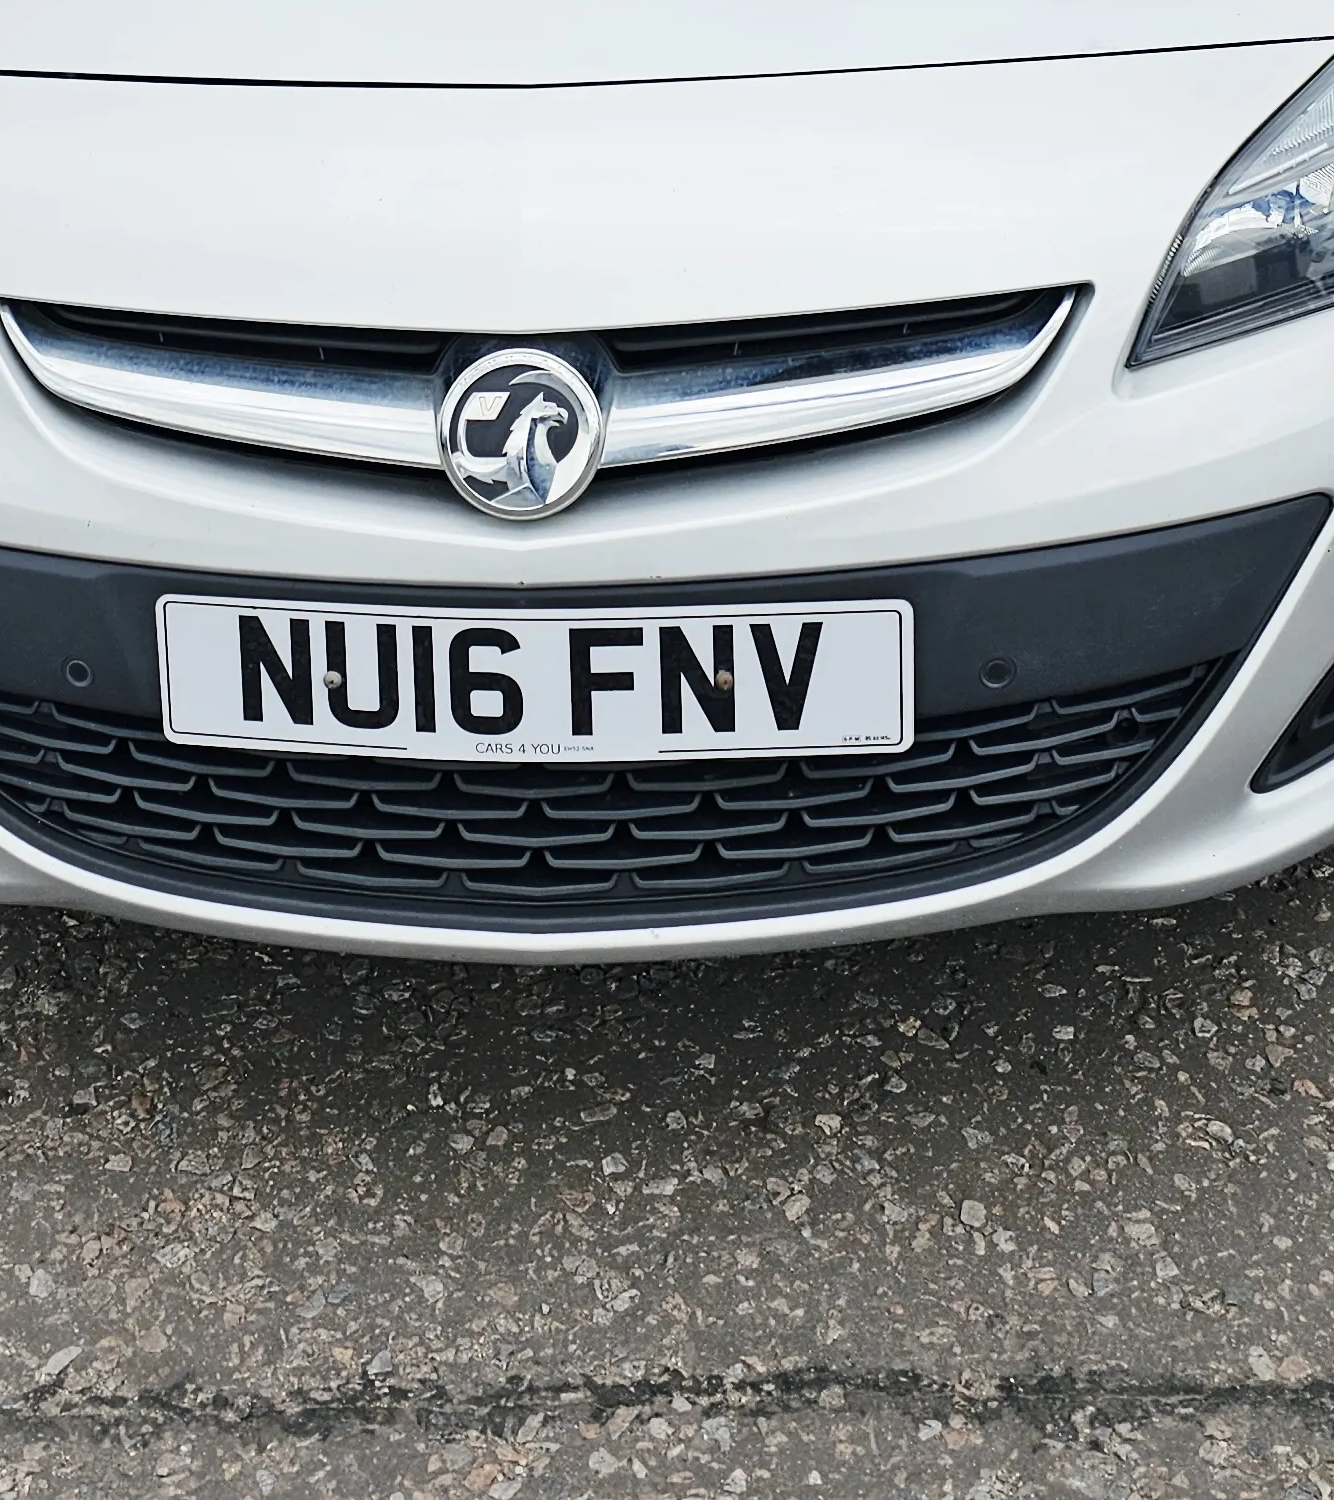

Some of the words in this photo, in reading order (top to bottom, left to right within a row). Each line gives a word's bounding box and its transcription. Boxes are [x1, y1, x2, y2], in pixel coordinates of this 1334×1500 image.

[238, 614, 524, 736] NU16
[568, 620, 824, 736] FNV
[475, 742, 514, 754] CARS
[518, 743, 526, 755] 4
[531, 742, 561, 755] YOU
